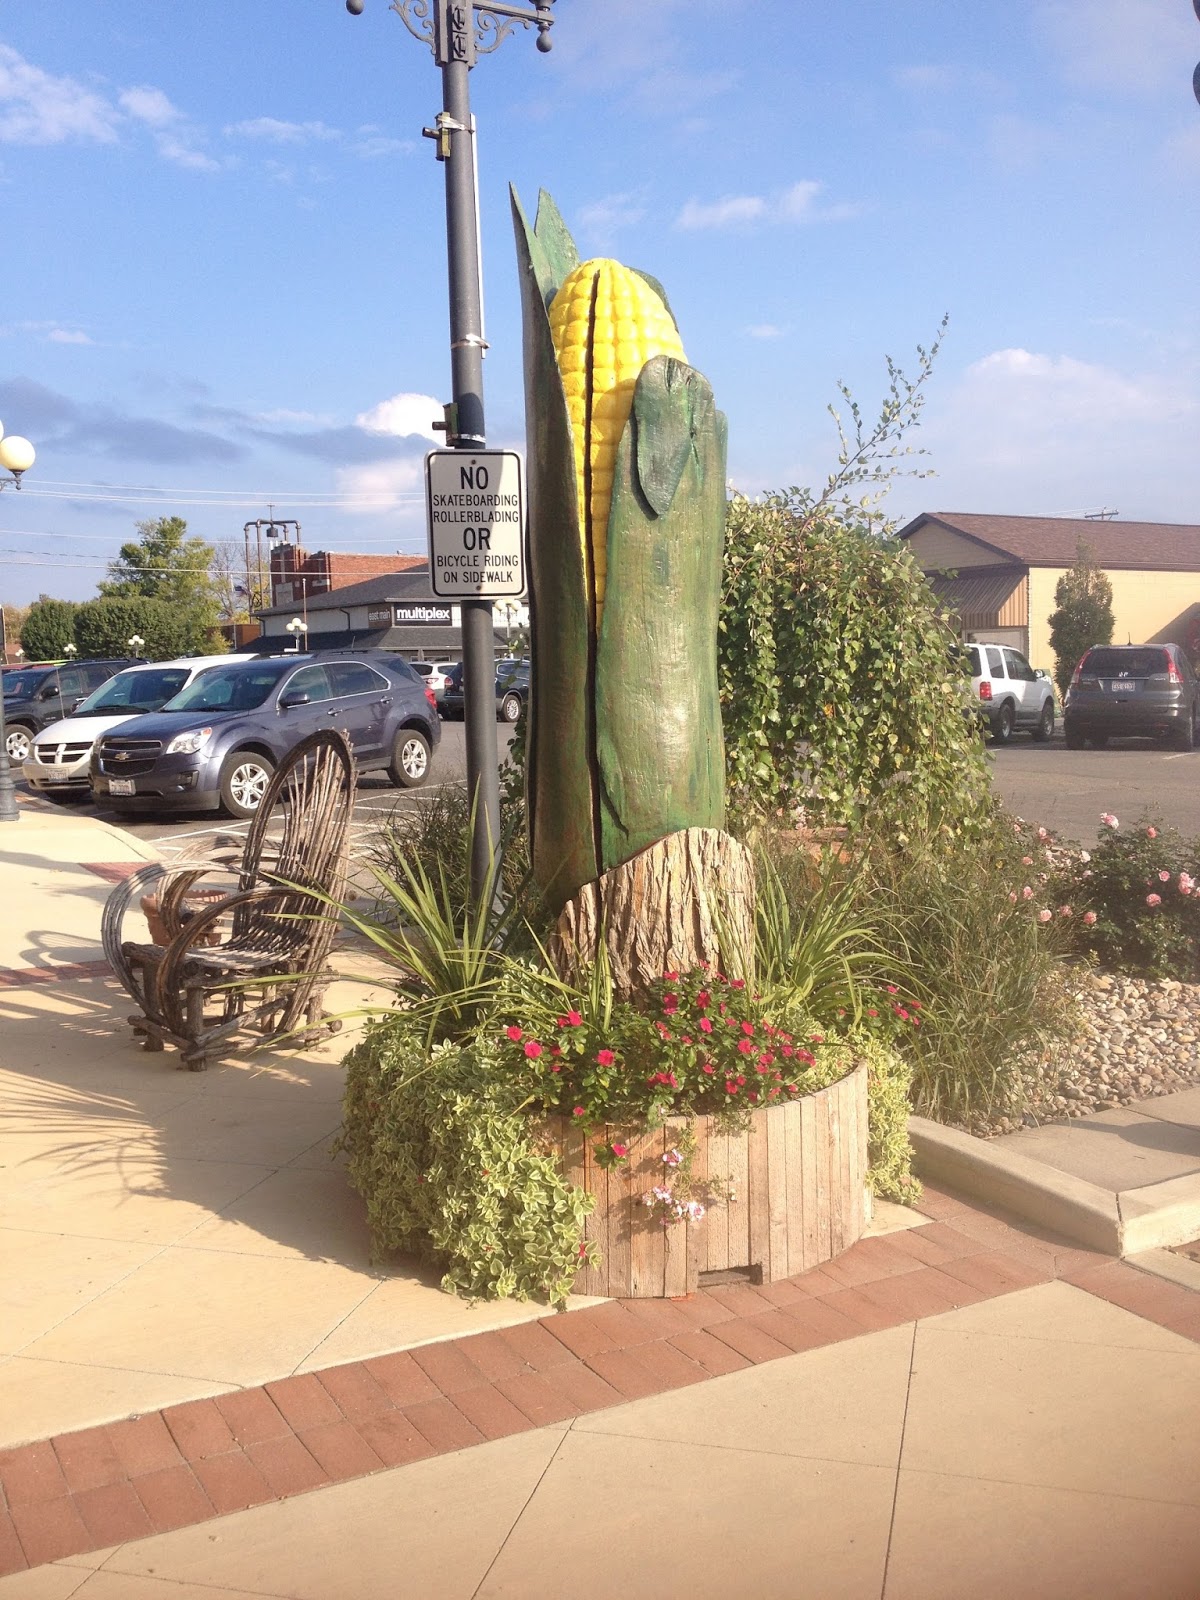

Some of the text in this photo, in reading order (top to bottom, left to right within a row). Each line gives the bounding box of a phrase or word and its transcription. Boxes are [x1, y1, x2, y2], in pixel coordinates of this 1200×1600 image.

[460, 466, 489, 490] NO
[433, 494, 518, 507] SKATEBOARDING
[433, 511, 519, 523] ROLLERBLADING
[463, 527, 491, 550] OR
[437, 555, 519, 567] BICYCLE RIDING
[443, 571, 514, 583] ON SIDEWALK
[396, 606, 450, 622] multiplex
